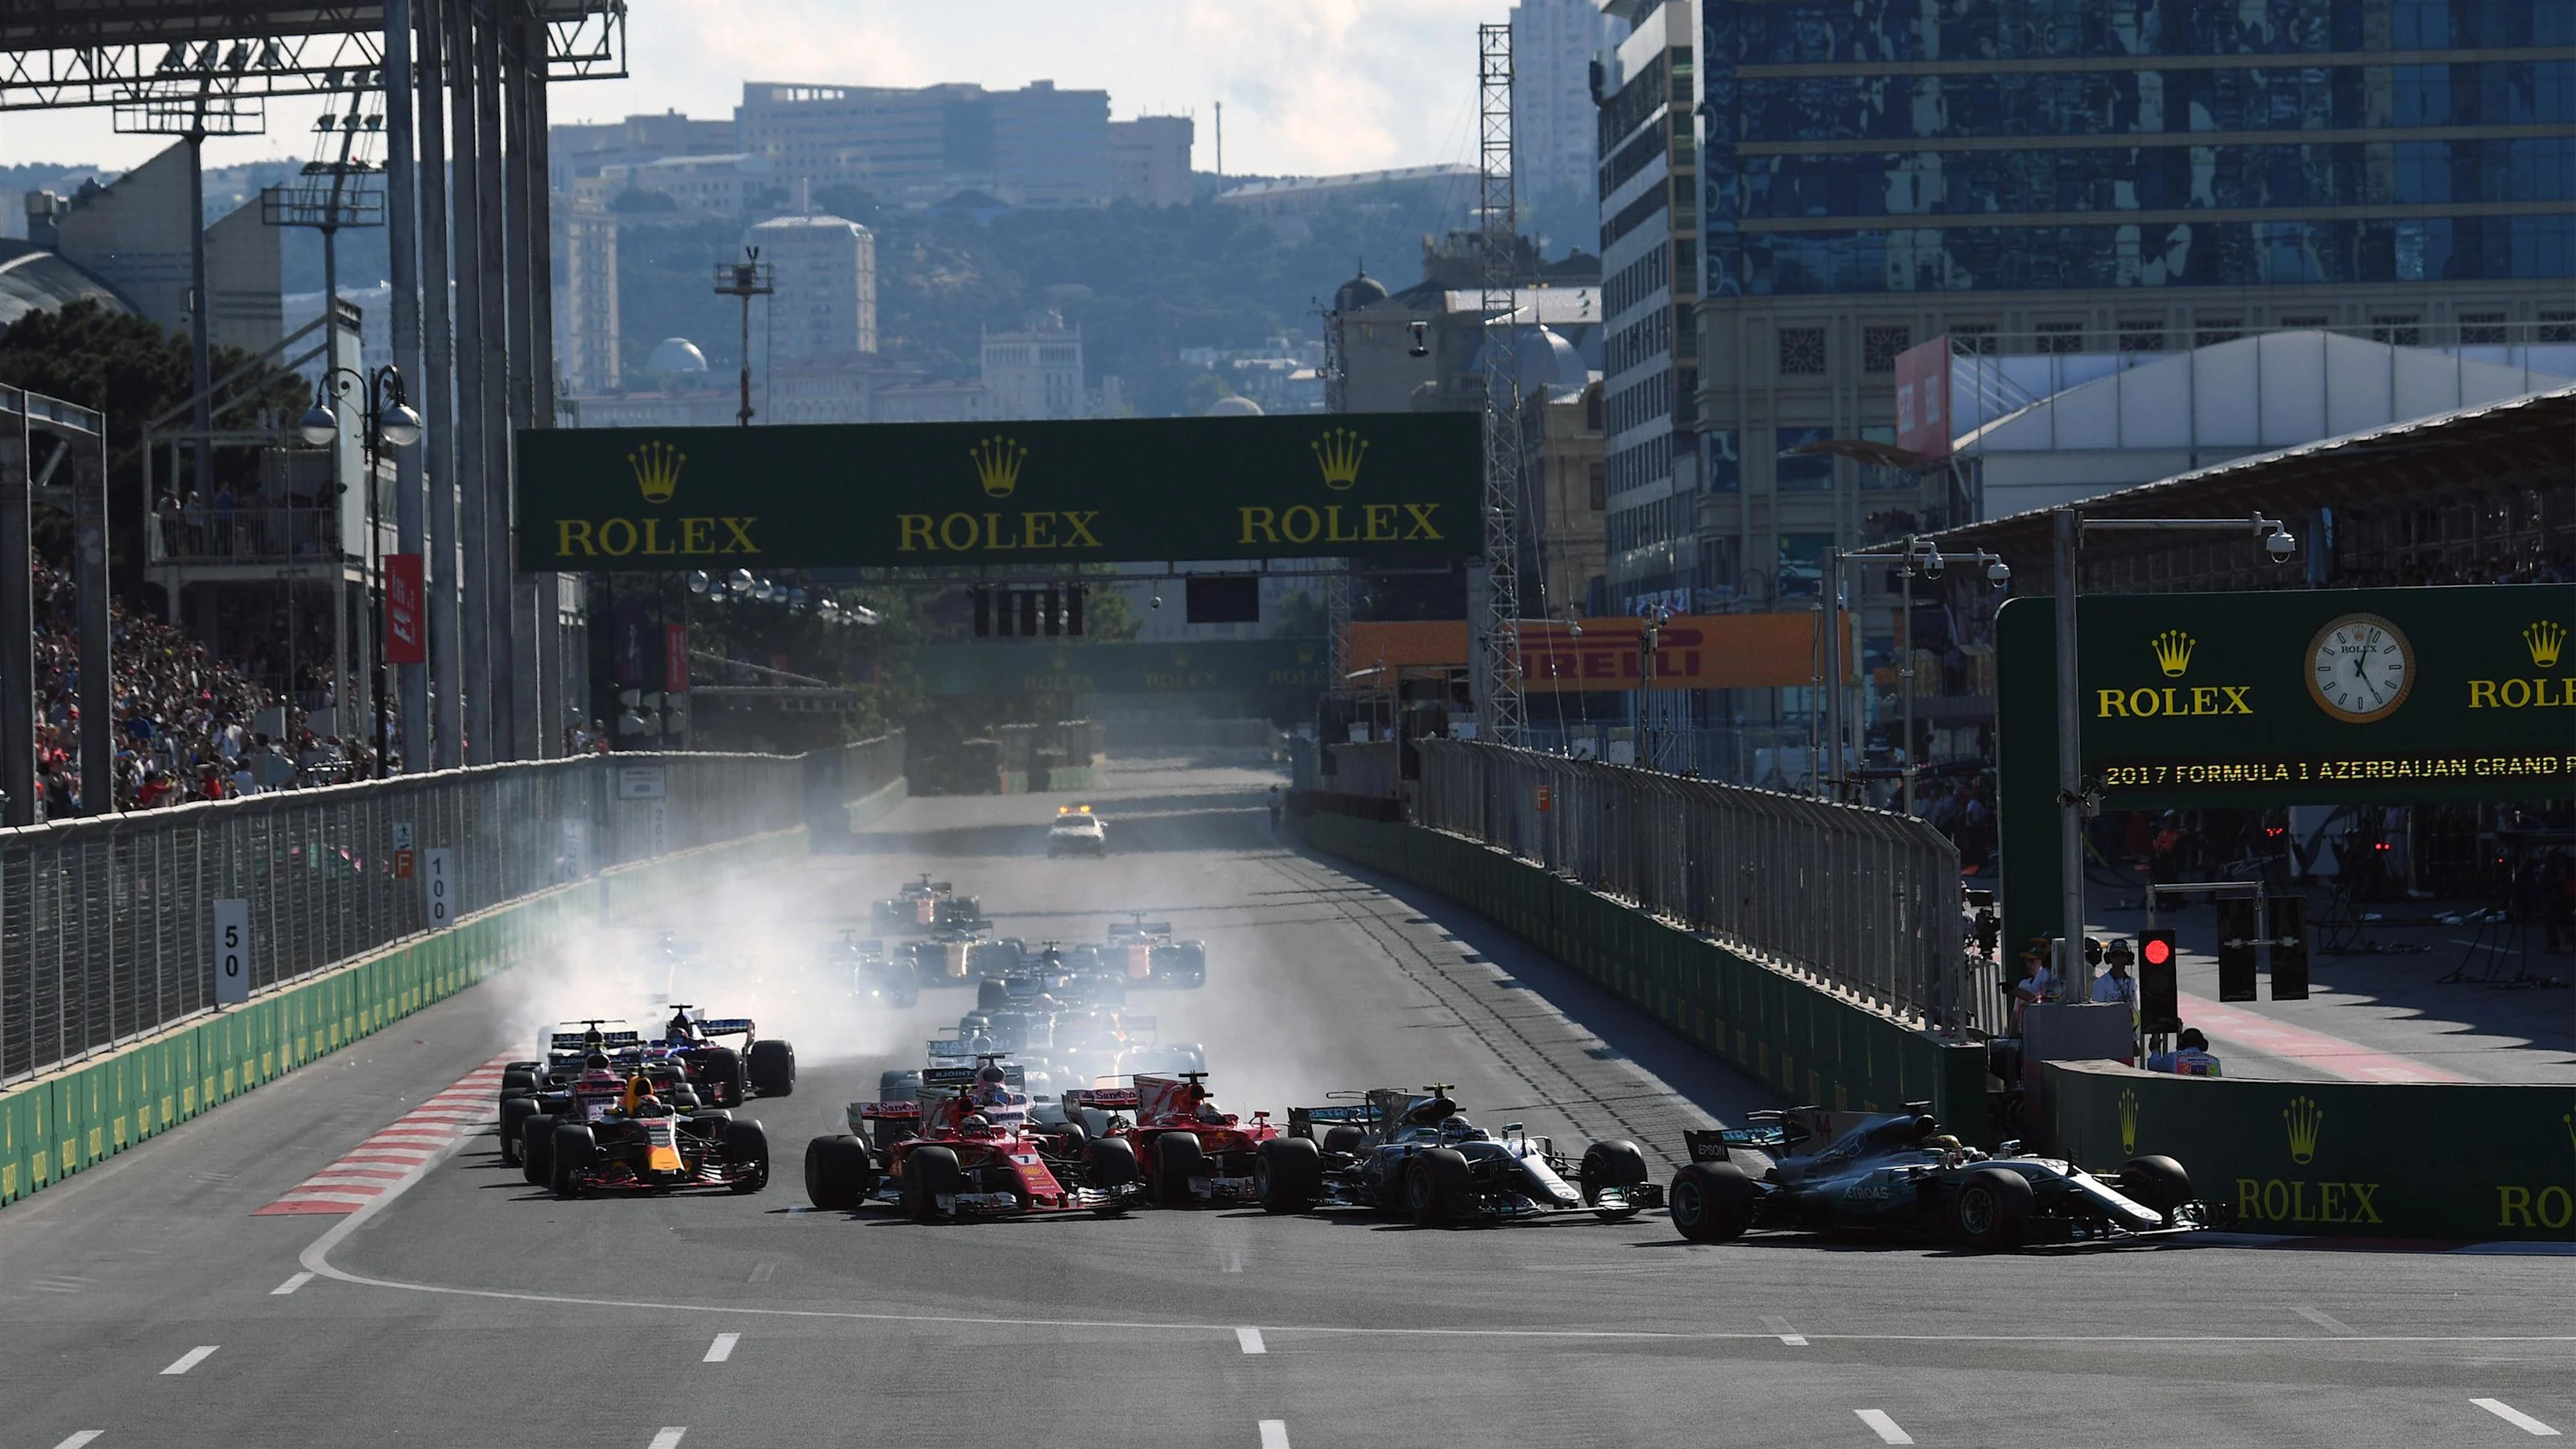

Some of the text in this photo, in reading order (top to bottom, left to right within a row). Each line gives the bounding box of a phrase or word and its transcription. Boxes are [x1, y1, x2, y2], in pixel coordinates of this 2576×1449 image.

[555, 517, 762, 556] ROLEX
[900, 511, 1100, 550] ROLEX
[1241, 504, 1444, 543] ROLEX
[1146, 671, 1218, 688] ROLEX
[1267, 667, 1328, 686] ROLE
[2097, 685, 2254, 718] ROLEX
[2107, 767, 2168, 786] 2017
[2175, 764, 2290, 782] FORMULA
[2299, 763, 2309, 781] 1
[2318, 759, 2468, 780] AZERBAIJAN
[2474, 757, 2558, 776] GRAND
[431, 857, 444, 919] 100
[225, 925, 239, 977] 50
[1017, 1155, 1029, 1164] 7
[1698, 1144, 1725, 1156] EPSON
[2236, 1179, 2383, 1224] ROLEX
